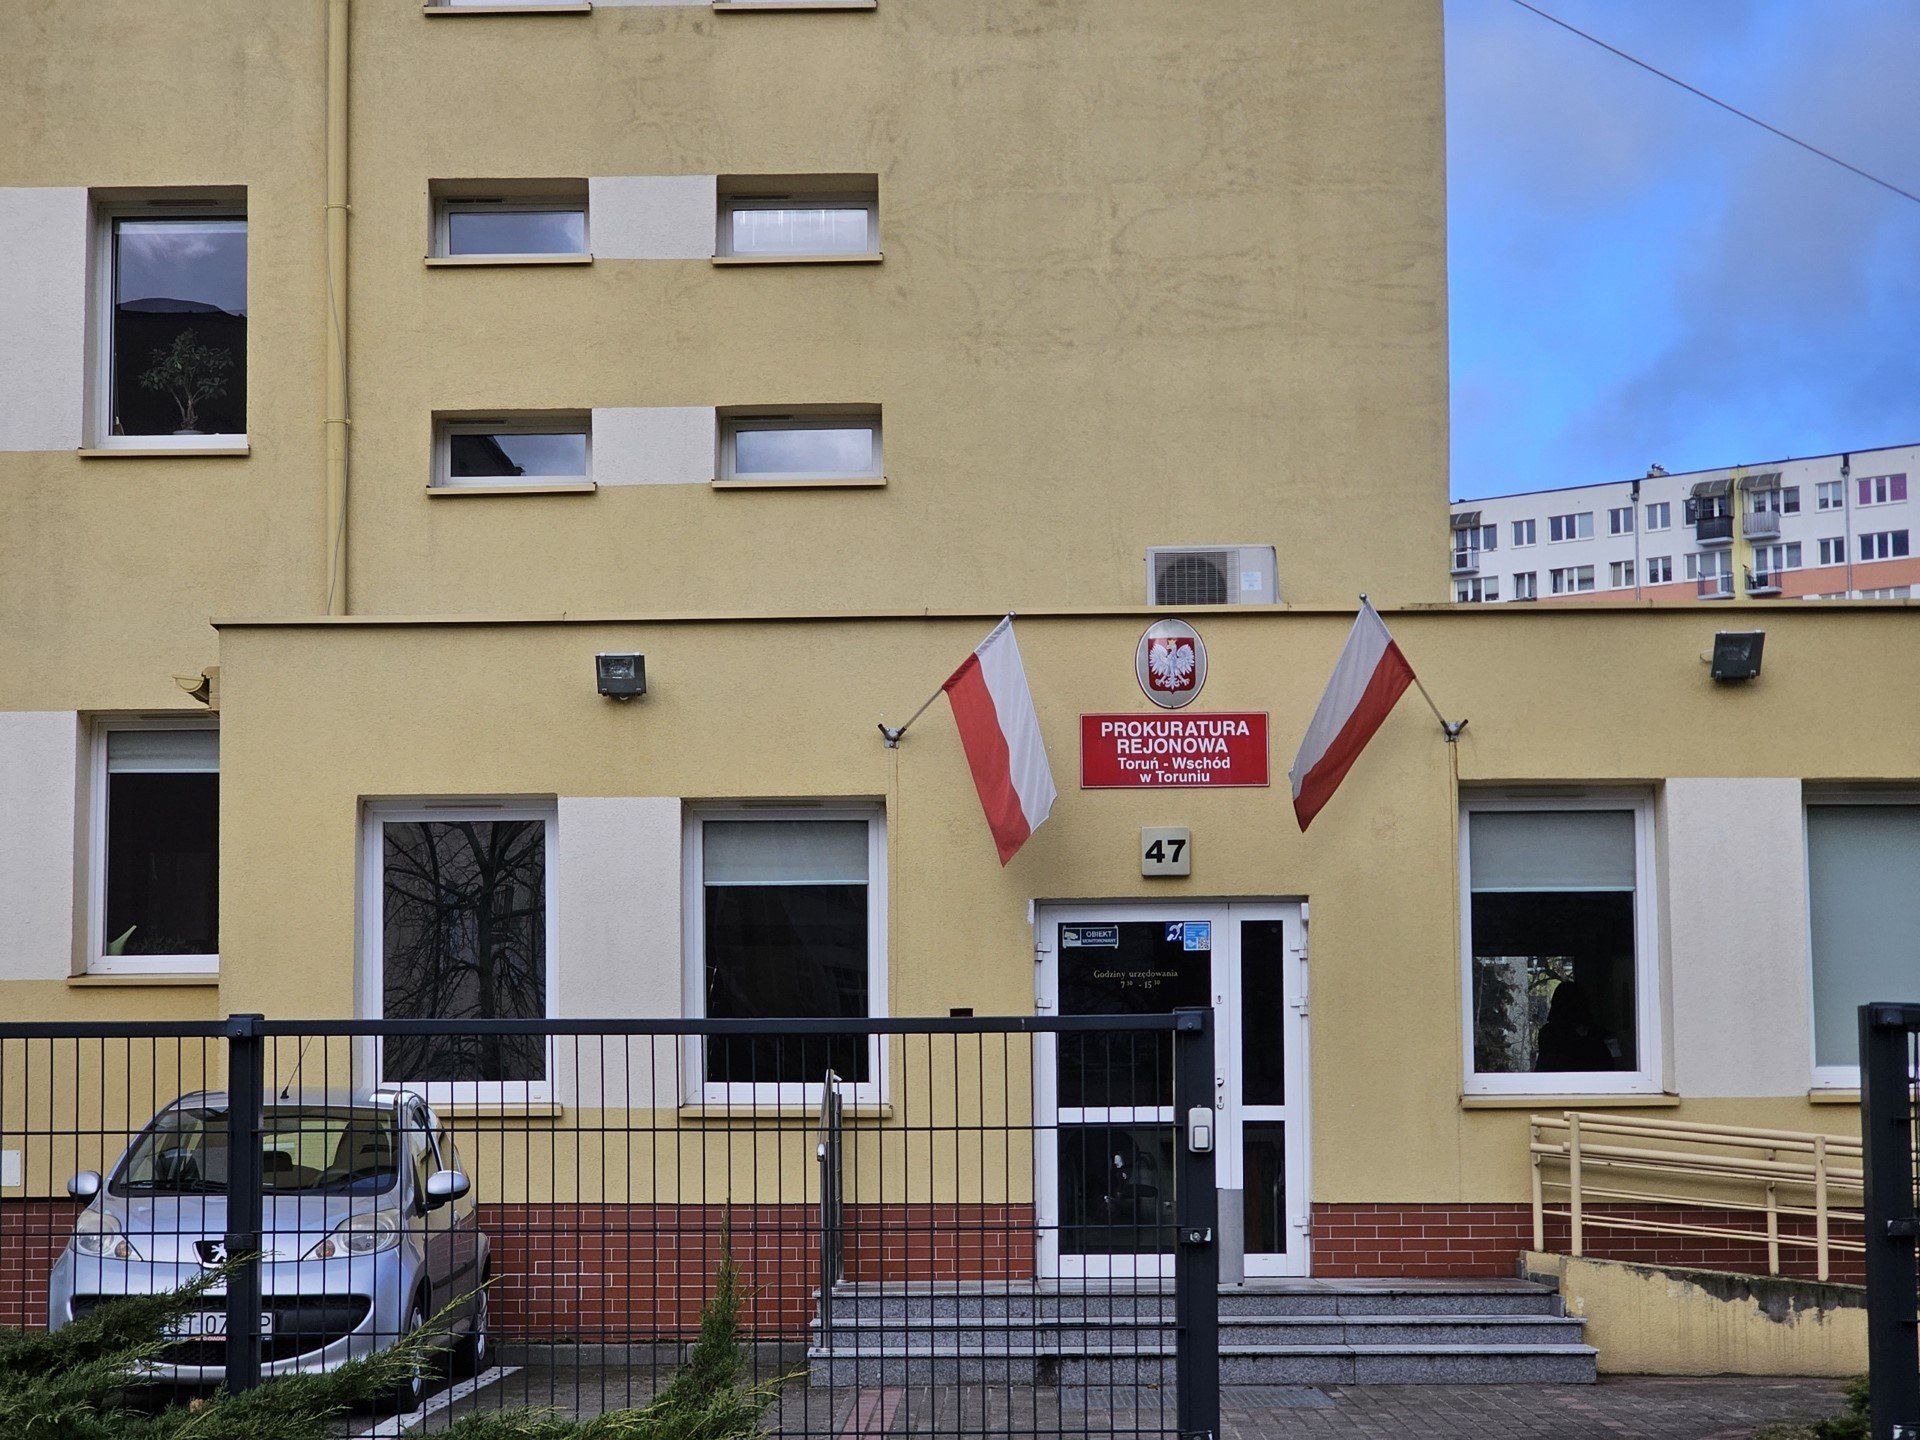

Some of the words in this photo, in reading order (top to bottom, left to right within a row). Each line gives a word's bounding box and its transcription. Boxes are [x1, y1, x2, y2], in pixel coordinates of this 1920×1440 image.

[1101, 720, 1250, 738] PROKURATURA
[1116, 737, 1229, 755] REJONOWA
[1117, 757, 1159, 770] Toruń
[1172, 756, 1231, 770] Wschód
[1139, 773, 1152, 783] w
[1155, 770, 1210, 783] Toruniu
[1144, 839, 1187, 864] 47
[1085, 930, 1112, 938] OBIEKT
[1093, 969, 1125, 980] Godziny
[1128, 969, 1179, 979] urzędowania
